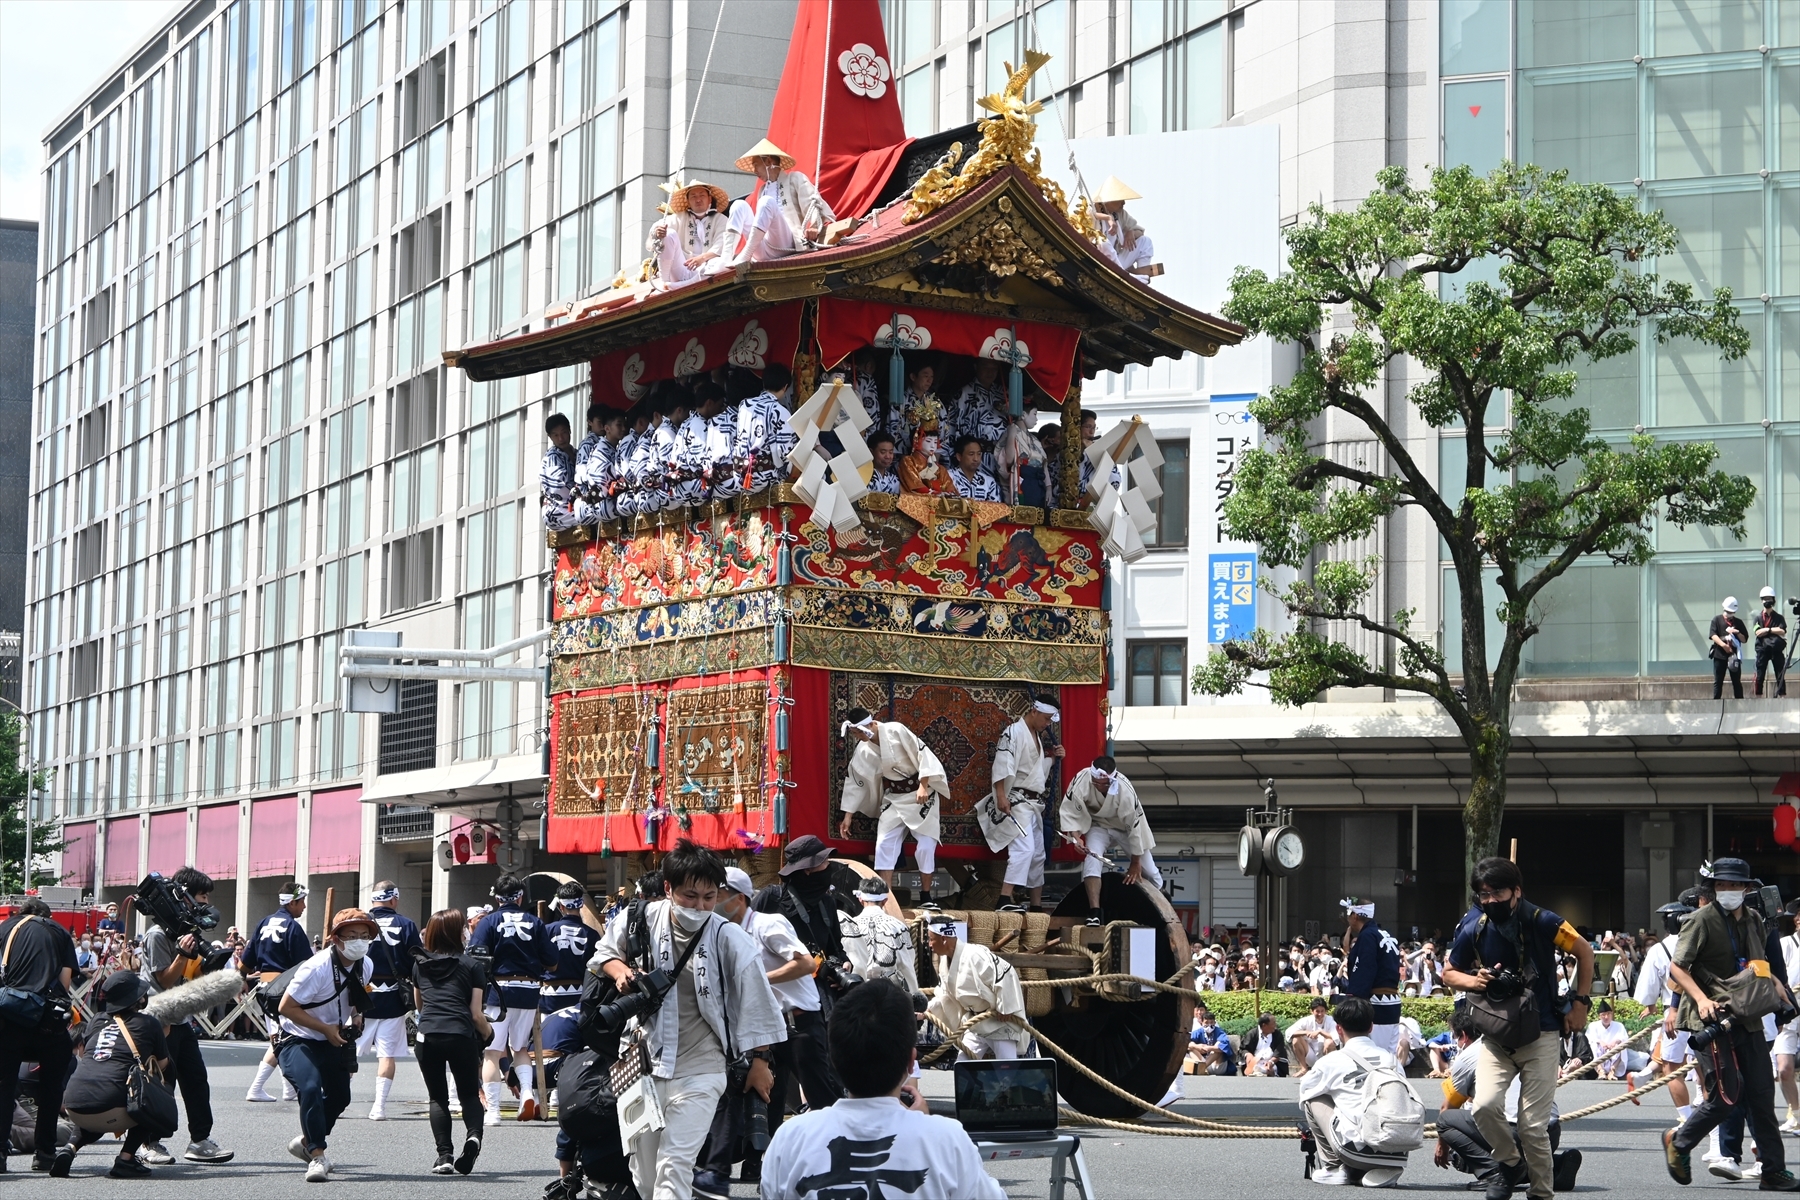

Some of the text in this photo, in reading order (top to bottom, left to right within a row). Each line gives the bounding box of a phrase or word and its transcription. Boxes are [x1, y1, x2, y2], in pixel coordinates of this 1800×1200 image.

[1212, 561, 1231, 641] 買えます
[1234, 563, 1250, 603] すぐ
[259, 916, 288, 944] 長
[496, 911, 534, 942] 長
[550, 924, 588, 956] 長
[695, 943, 711, 999] 長刀鉾
